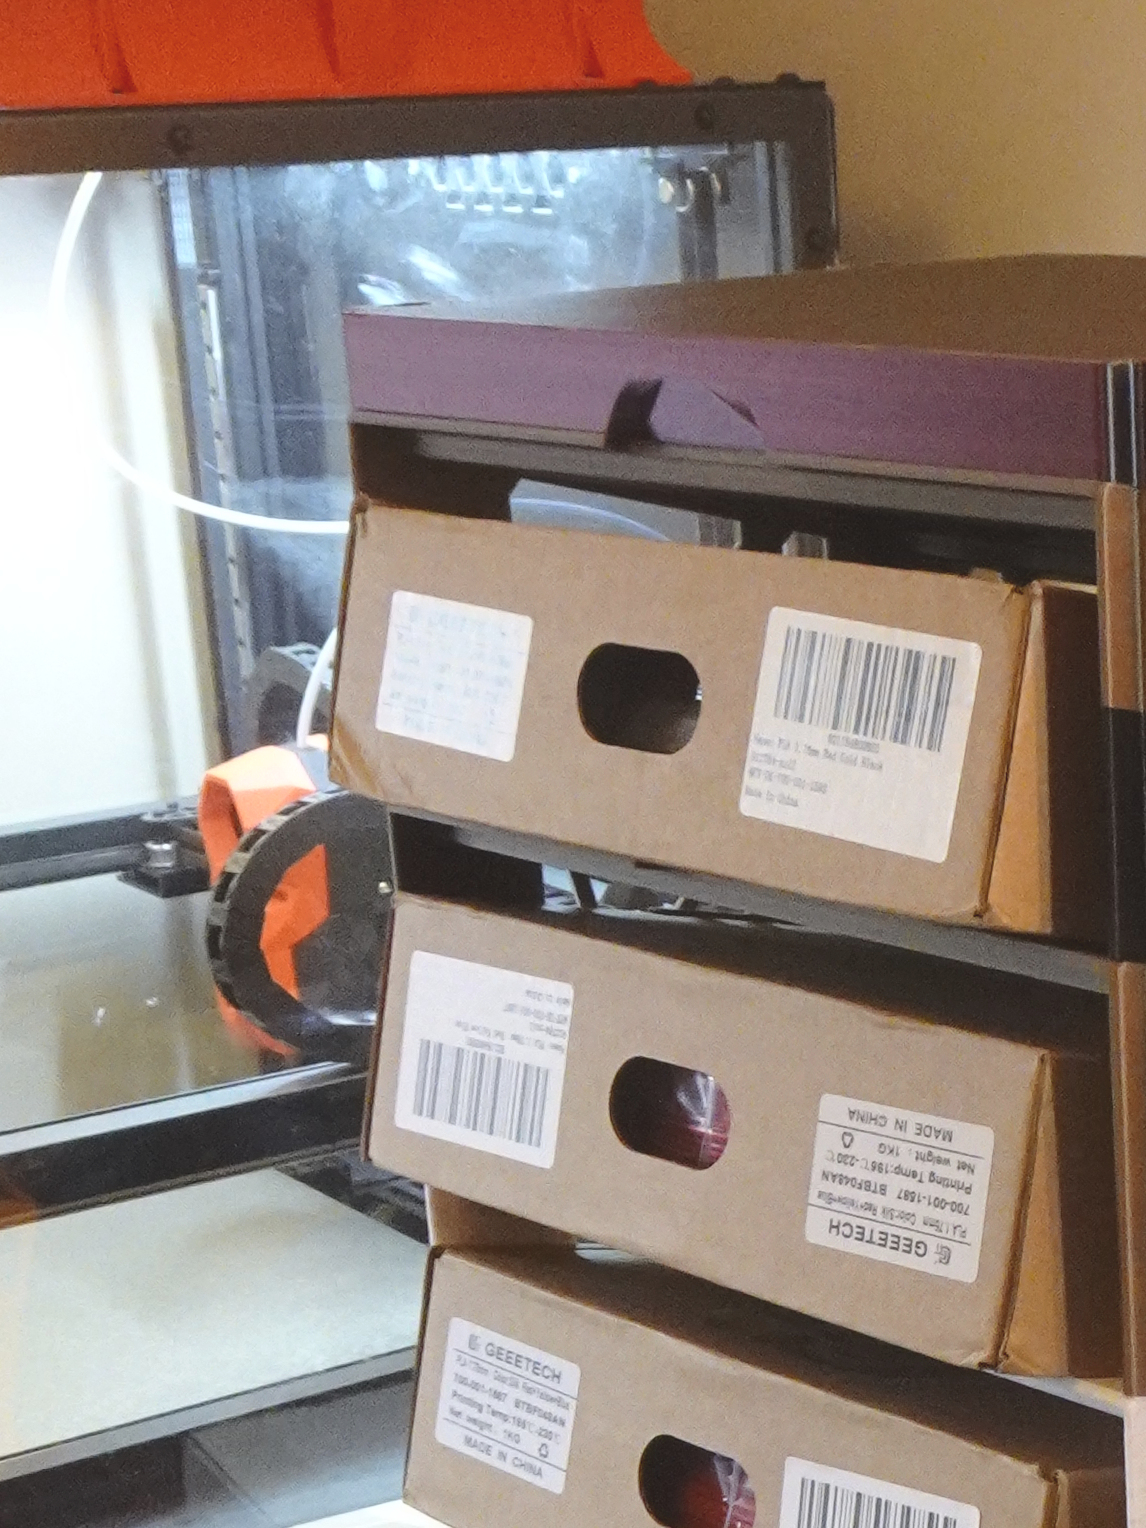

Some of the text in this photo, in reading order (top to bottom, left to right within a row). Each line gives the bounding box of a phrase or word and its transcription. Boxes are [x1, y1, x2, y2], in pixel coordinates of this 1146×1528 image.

[847, 1107, 954, 1144] MADE IN CHINA
[928, 1170, 973, 1195] Printing
[956, 1160, 976, 1175] Net
[828, 1218, 928, 1258] GEEETECH
[484, 1342, 562, 1385] GEEETECH
